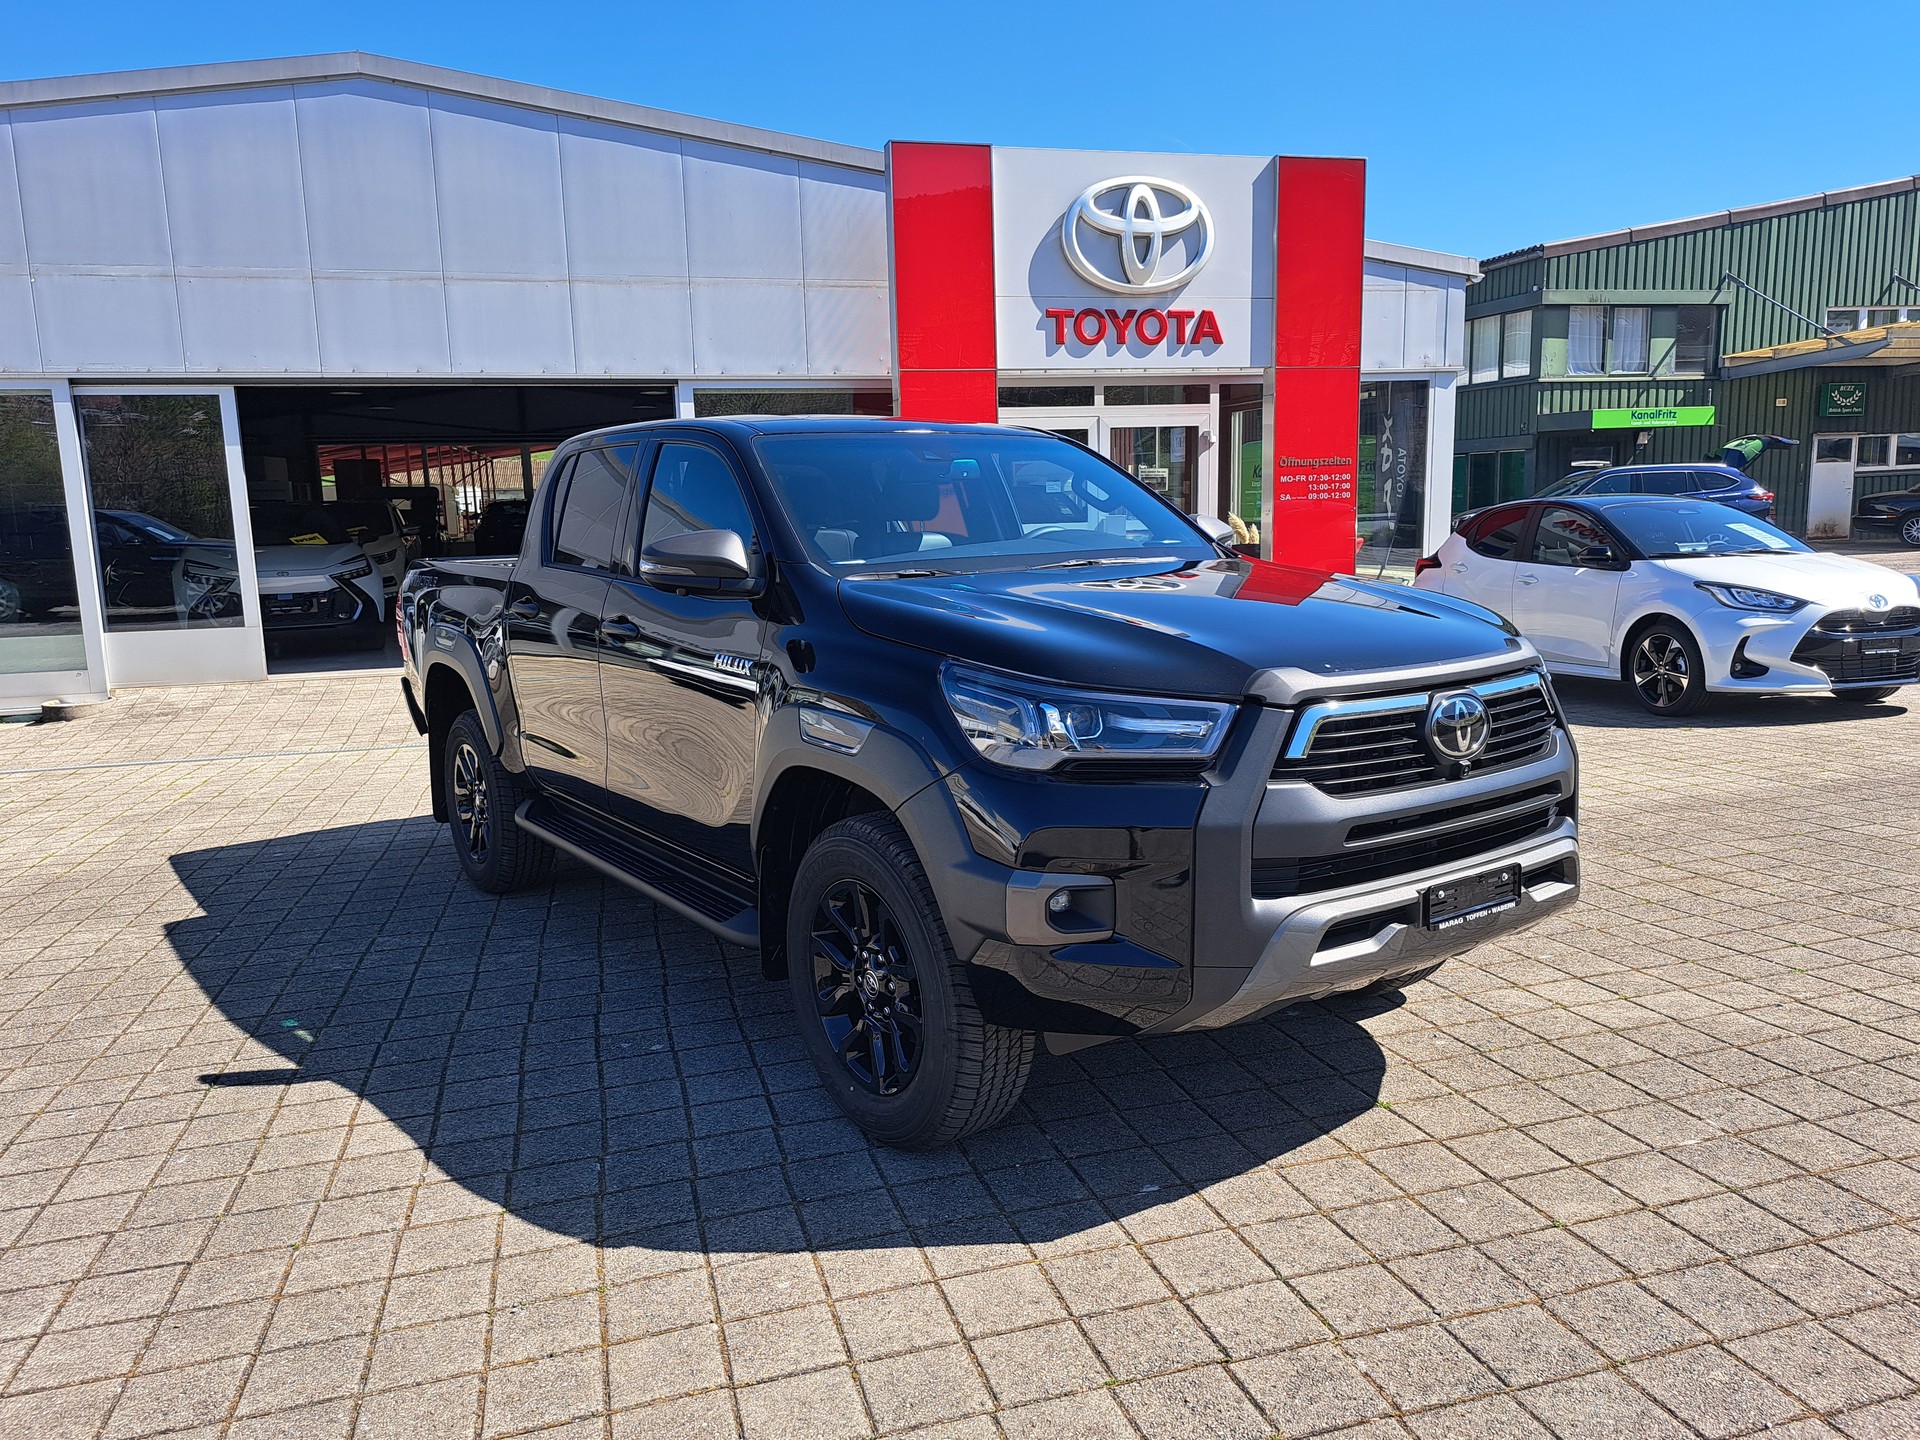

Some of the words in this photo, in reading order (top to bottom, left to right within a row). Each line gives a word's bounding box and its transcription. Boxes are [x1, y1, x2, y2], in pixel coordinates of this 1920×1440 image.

[1045, 308, 1224, 346] TOYOTA
[1630, 409, 1678, 420] KanalFritz
[1280, 475, 1307, 483] MO-FR
[1308, 473, 1351, 482] 07:30-12:00
[1308, 482, 1351, 491] 13:00-17:00
[1280, 493, 1292, 501] SA
[1308, 491, 1351, 500] 09:00-12:00
[713, 652, 754, 676] HILUX
[1439, 917, 1464, 930] MARAG
[1465, 909, 1488, 922] TOFFEN
[1491, 901, 1516, 914] WABERN
